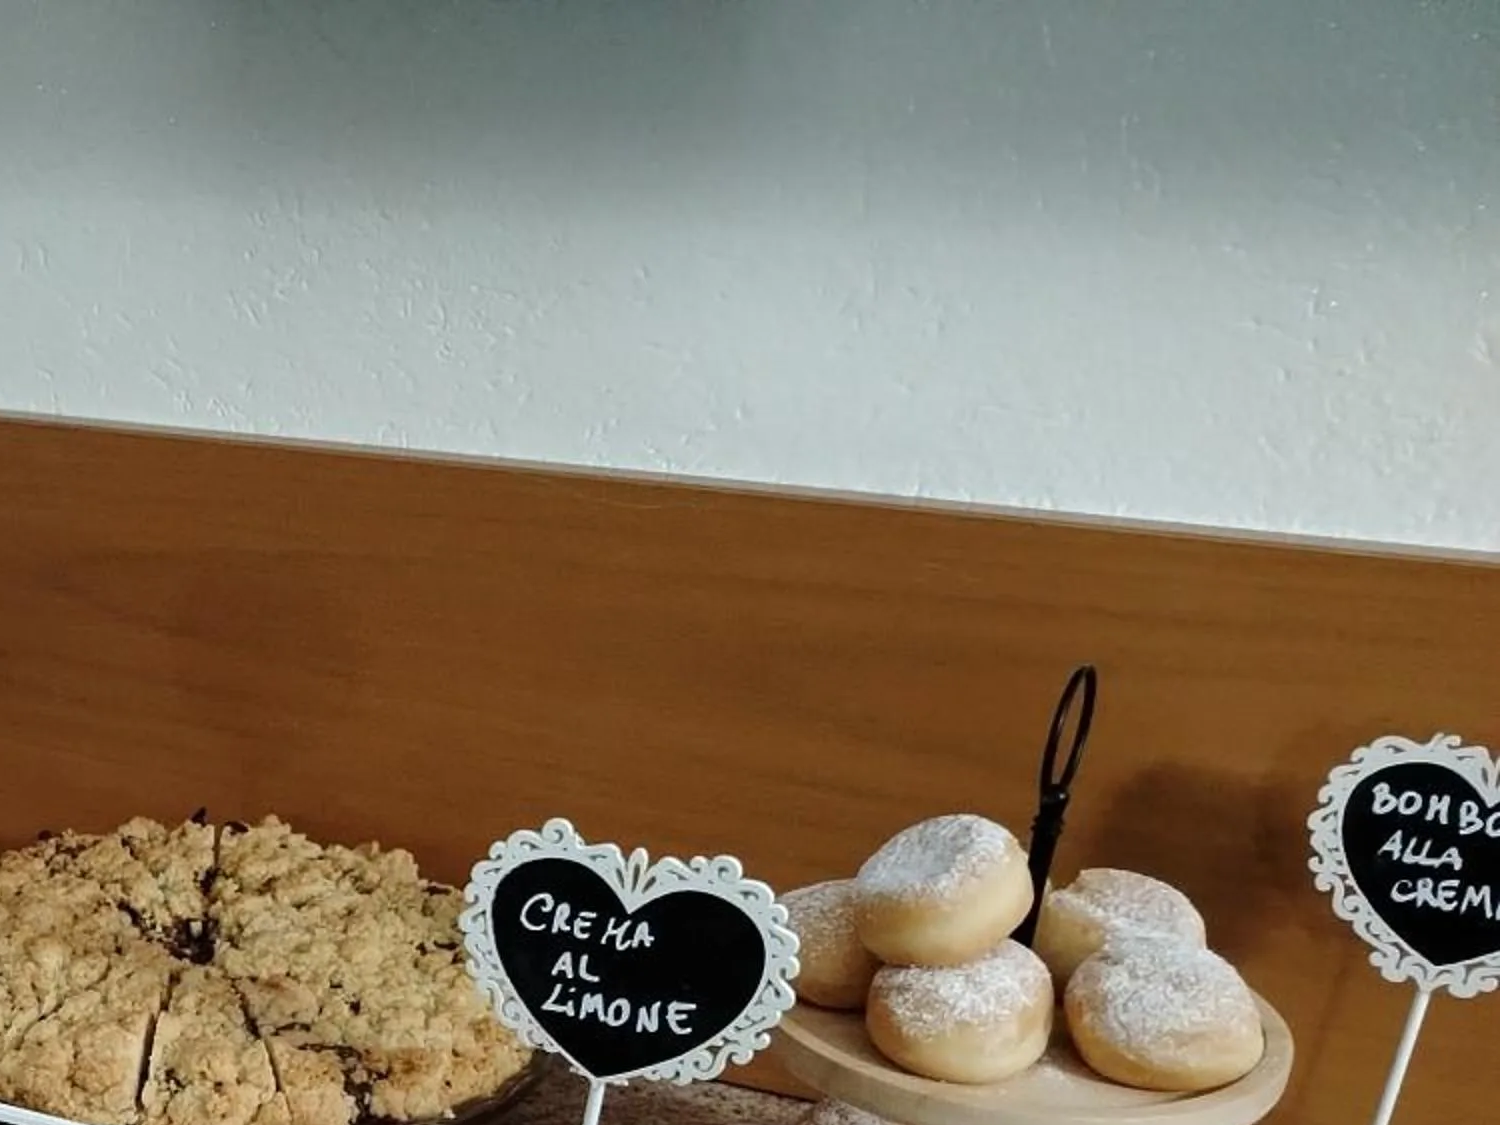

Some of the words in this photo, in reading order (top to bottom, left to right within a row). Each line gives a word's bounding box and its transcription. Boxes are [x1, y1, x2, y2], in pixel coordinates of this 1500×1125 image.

[1378, 830, 1463, 871] ALLA
[1390, 877, 1500, 921] CREM
[519, 892, 655, 951] CREMA
[551, 951, 600, 983] AL
